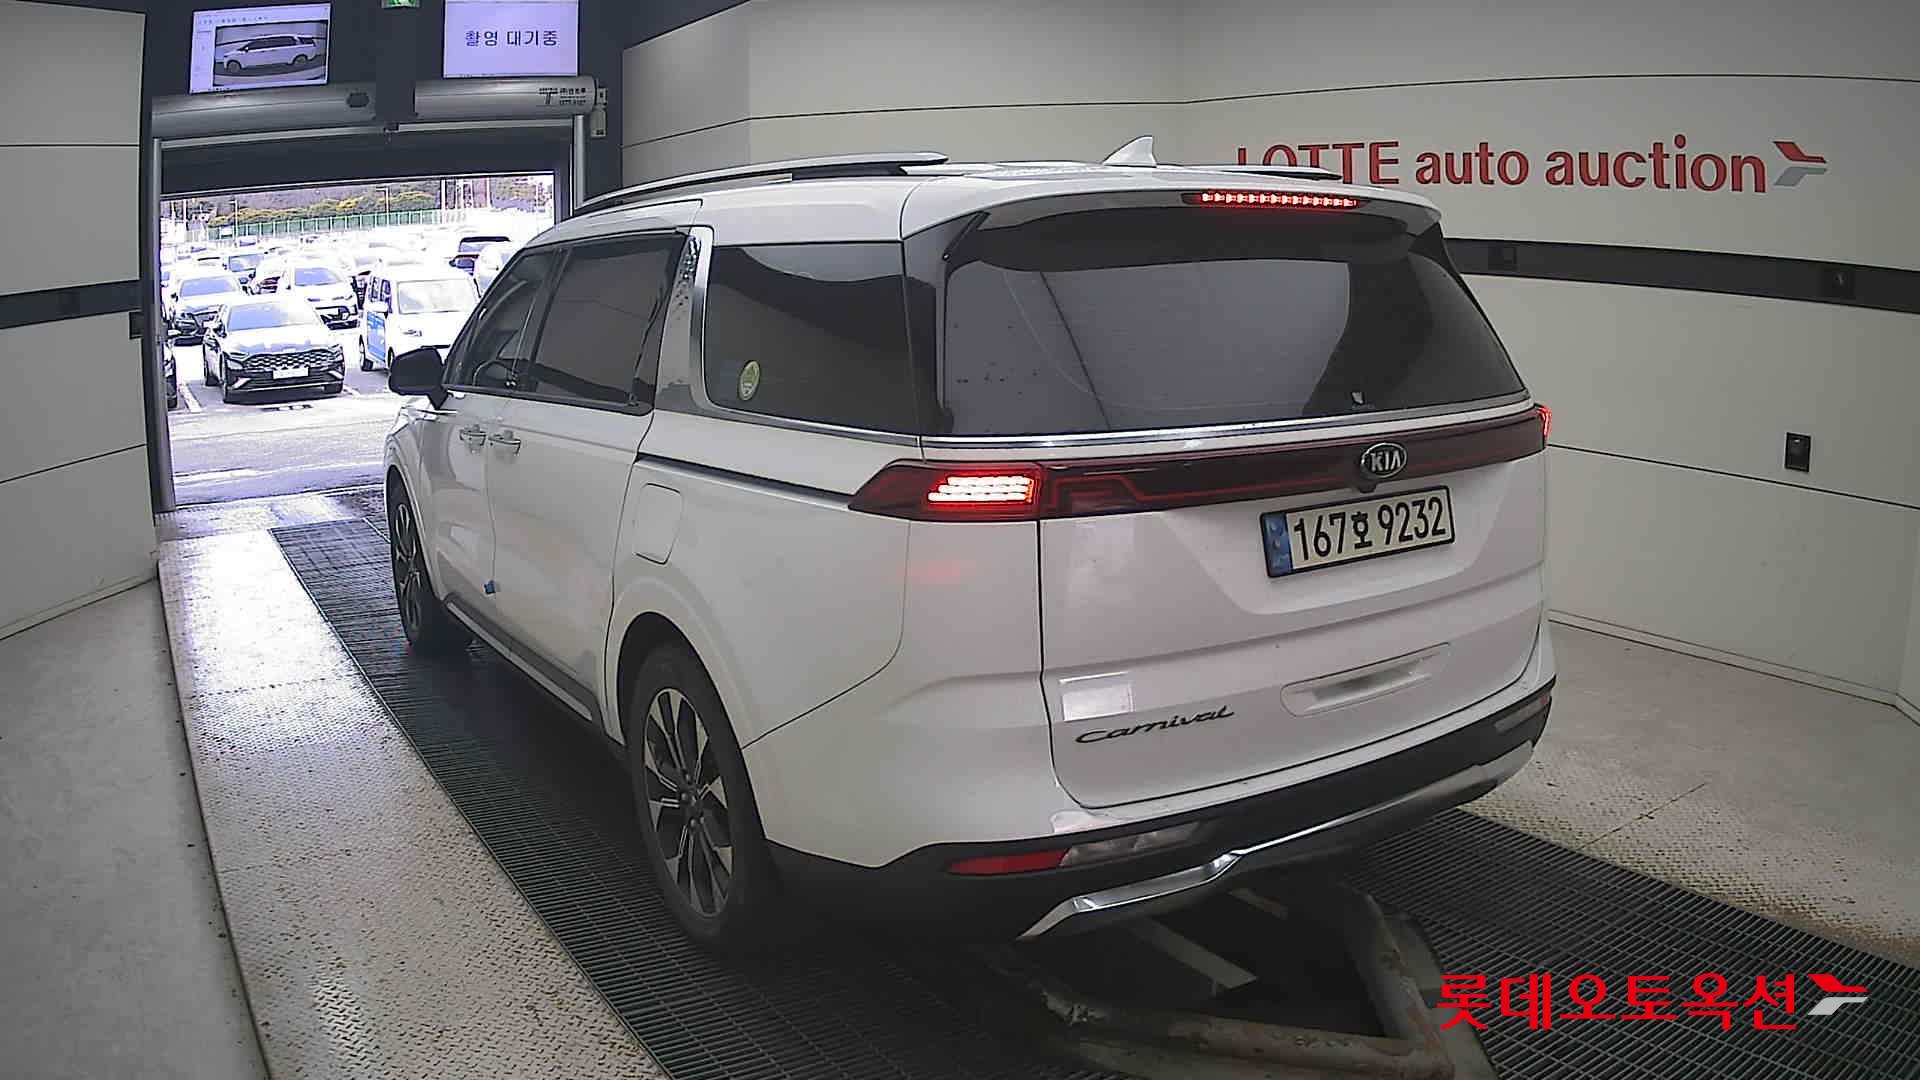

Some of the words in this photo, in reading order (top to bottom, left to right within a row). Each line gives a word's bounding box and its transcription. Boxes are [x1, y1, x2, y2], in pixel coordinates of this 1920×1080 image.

[465, 30, 498, 47] 촬영
[506, 30, 557, 47] 대기중
[1415, 142, 1530, 185] auto
[1545, 134, 1766, 193] auction
[1370, 450, 1401, 473] KIA
[1293, 511, 1373, 560] 167호
[1377, 496, 1446, 545] 9232
[1075, 705, 1235, 743] Carnival
